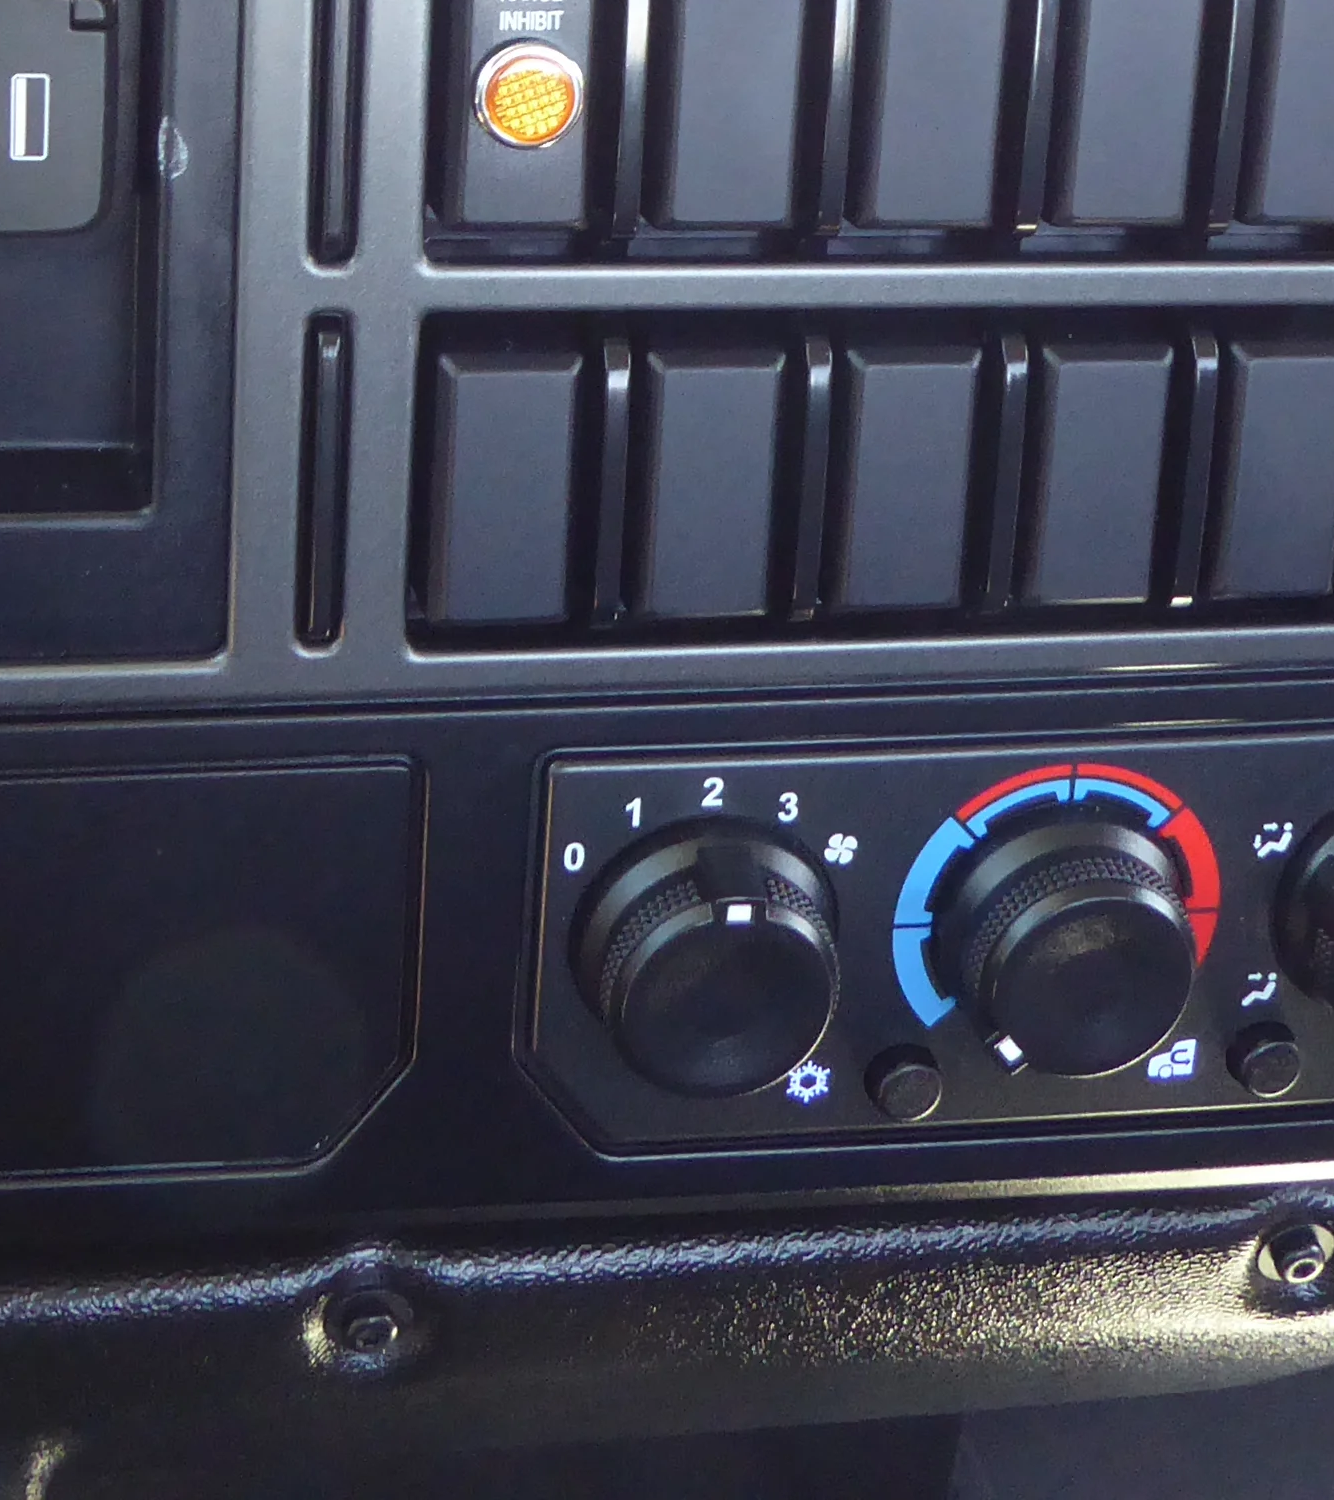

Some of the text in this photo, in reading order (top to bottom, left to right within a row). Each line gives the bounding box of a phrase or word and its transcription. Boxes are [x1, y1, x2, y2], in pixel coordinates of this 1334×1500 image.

[499, 10, 564, 31] INHIBIT
[701, 777, 725, 807] 2
[777, 792, 799, 822] 3
[625, 797, 642, 828] 1
[563, 842, 585, 872] 0
